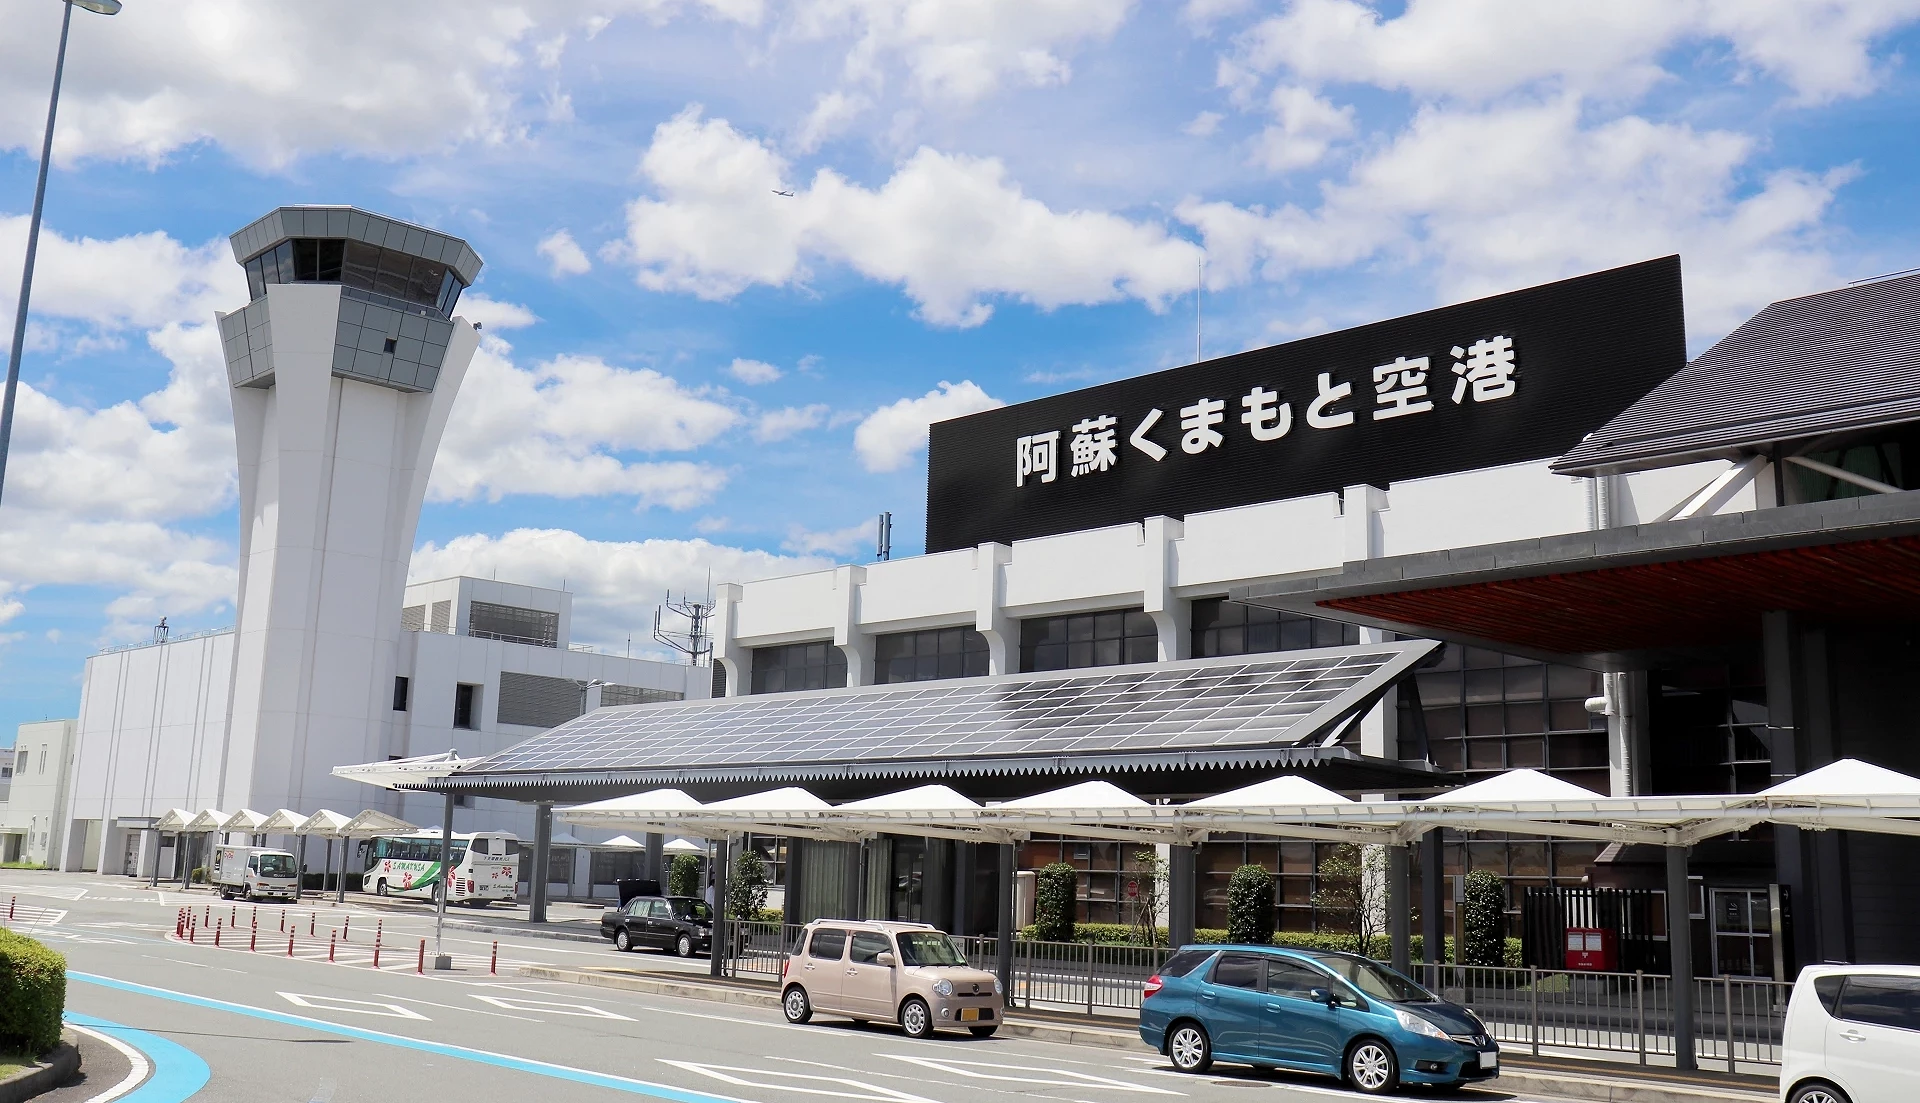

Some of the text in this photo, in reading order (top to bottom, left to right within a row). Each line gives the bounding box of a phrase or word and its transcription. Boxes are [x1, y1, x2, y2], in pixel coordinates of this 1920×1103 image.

[1016, 335, 1517, 487] 阿蘇くまもと空港
